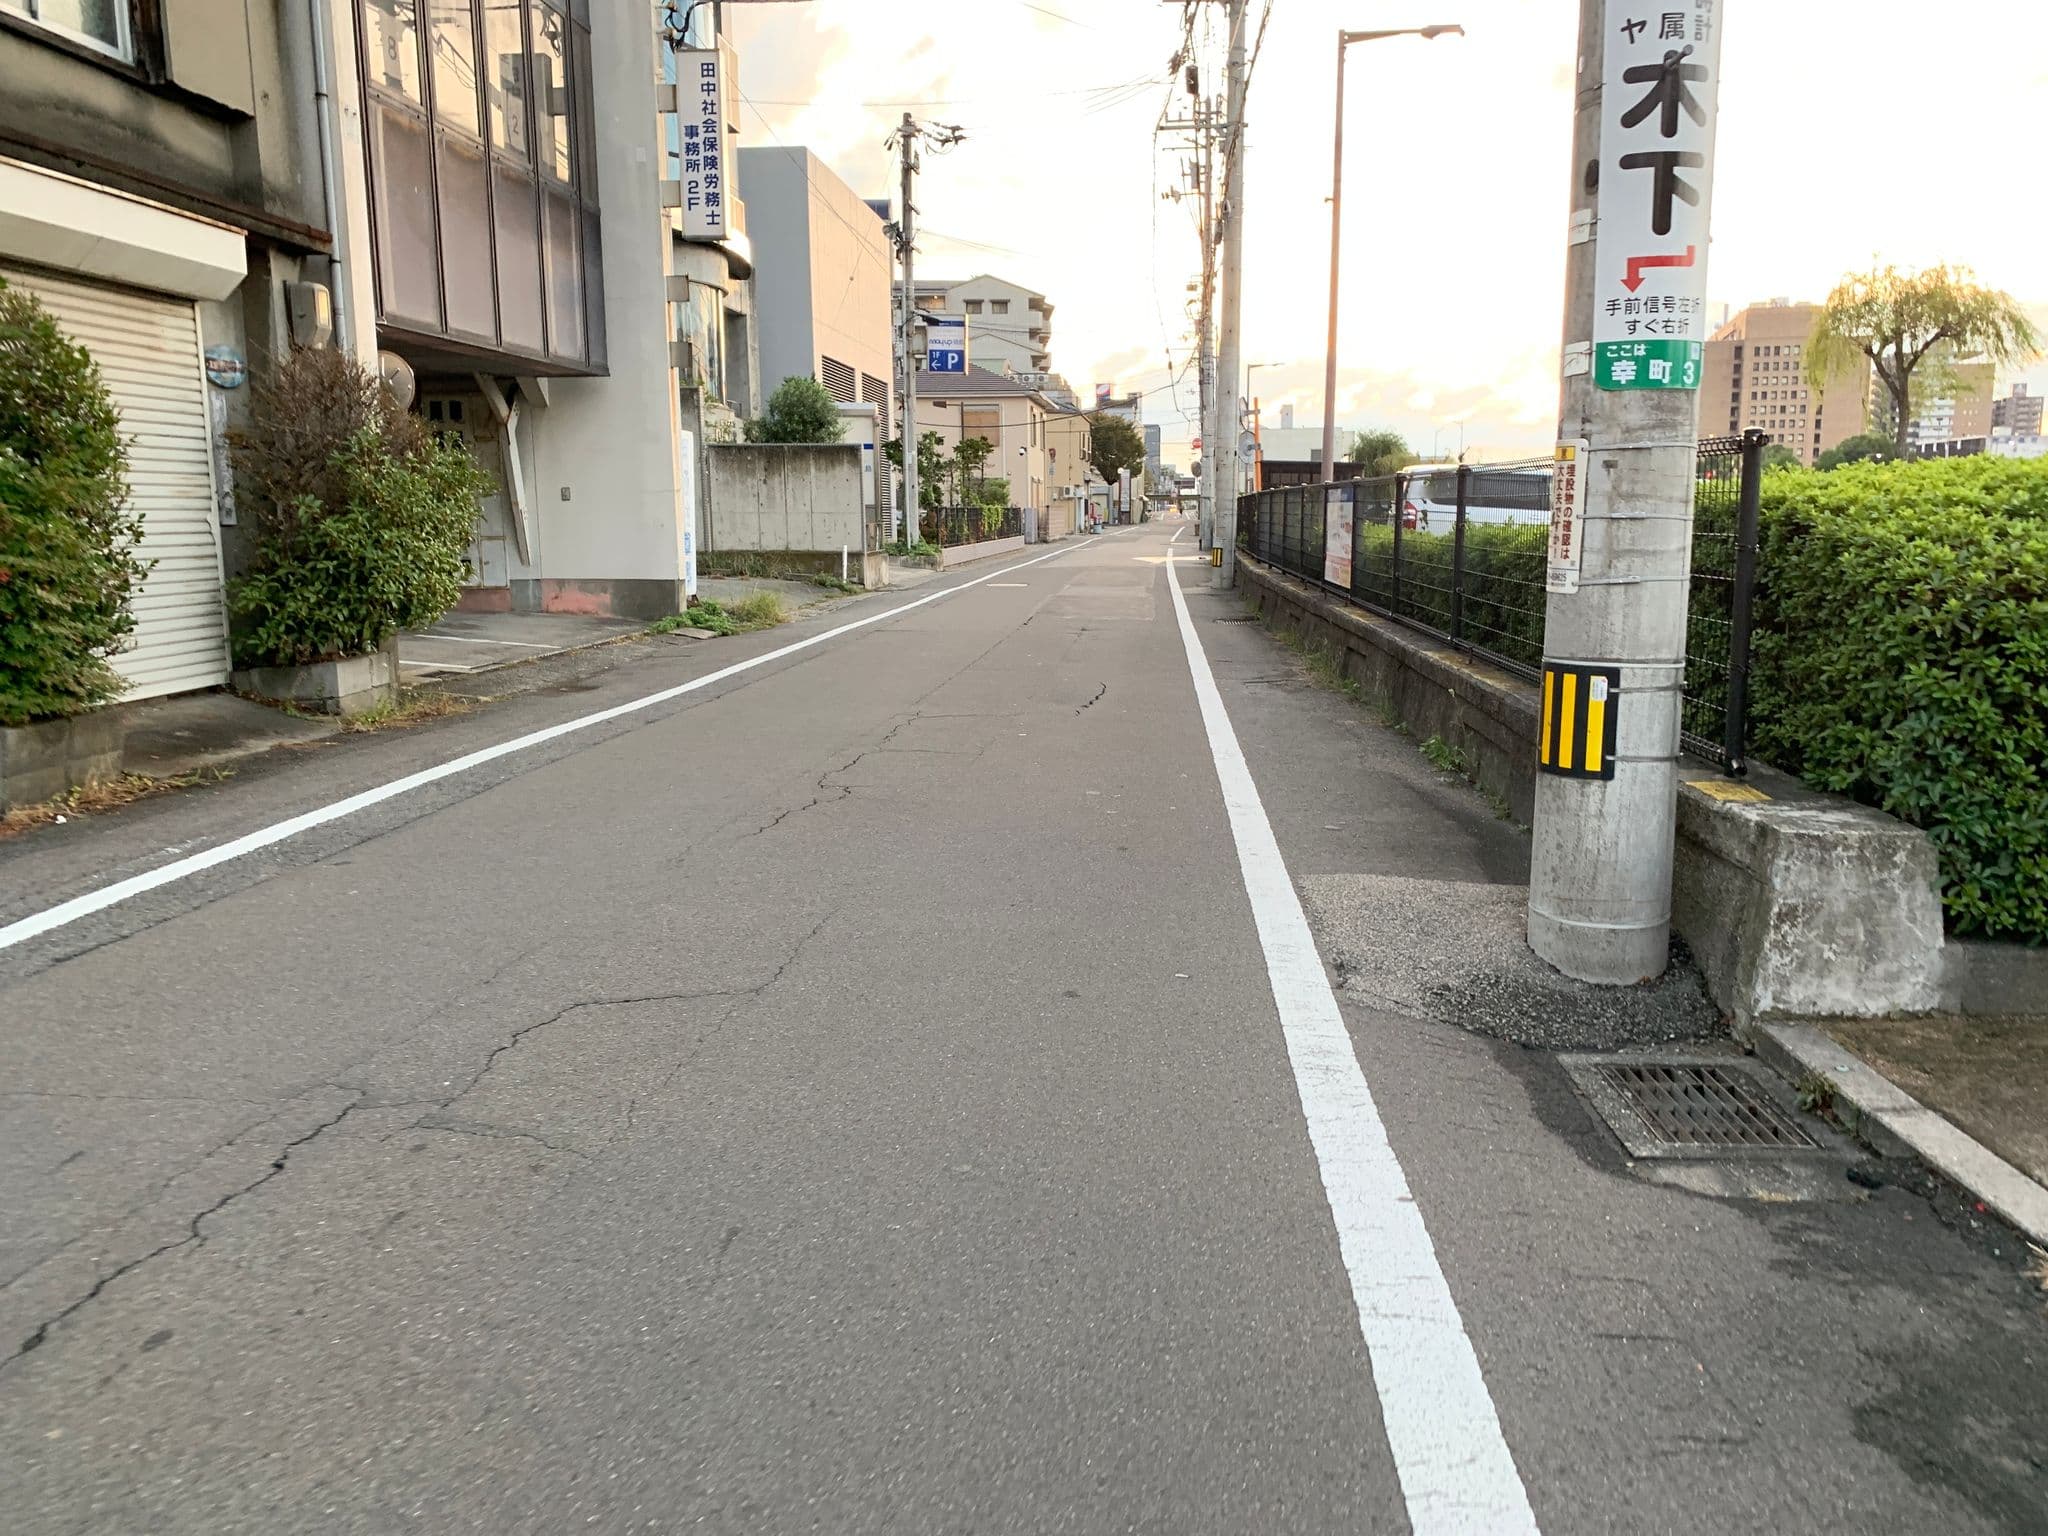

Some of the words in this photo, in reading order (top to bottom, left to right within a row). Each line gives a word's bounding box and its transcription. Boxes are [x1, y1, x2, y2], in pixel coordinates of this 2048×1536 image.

[700, 62, 721, 226] 田中社会保険労務士
[1619, 49, 1709, 236] 木下
[947, 352, 959, 370] P
[1606, 343, 1647, 358] ここは
[1560, 463, 1577, 560] 埋設物の確認は
